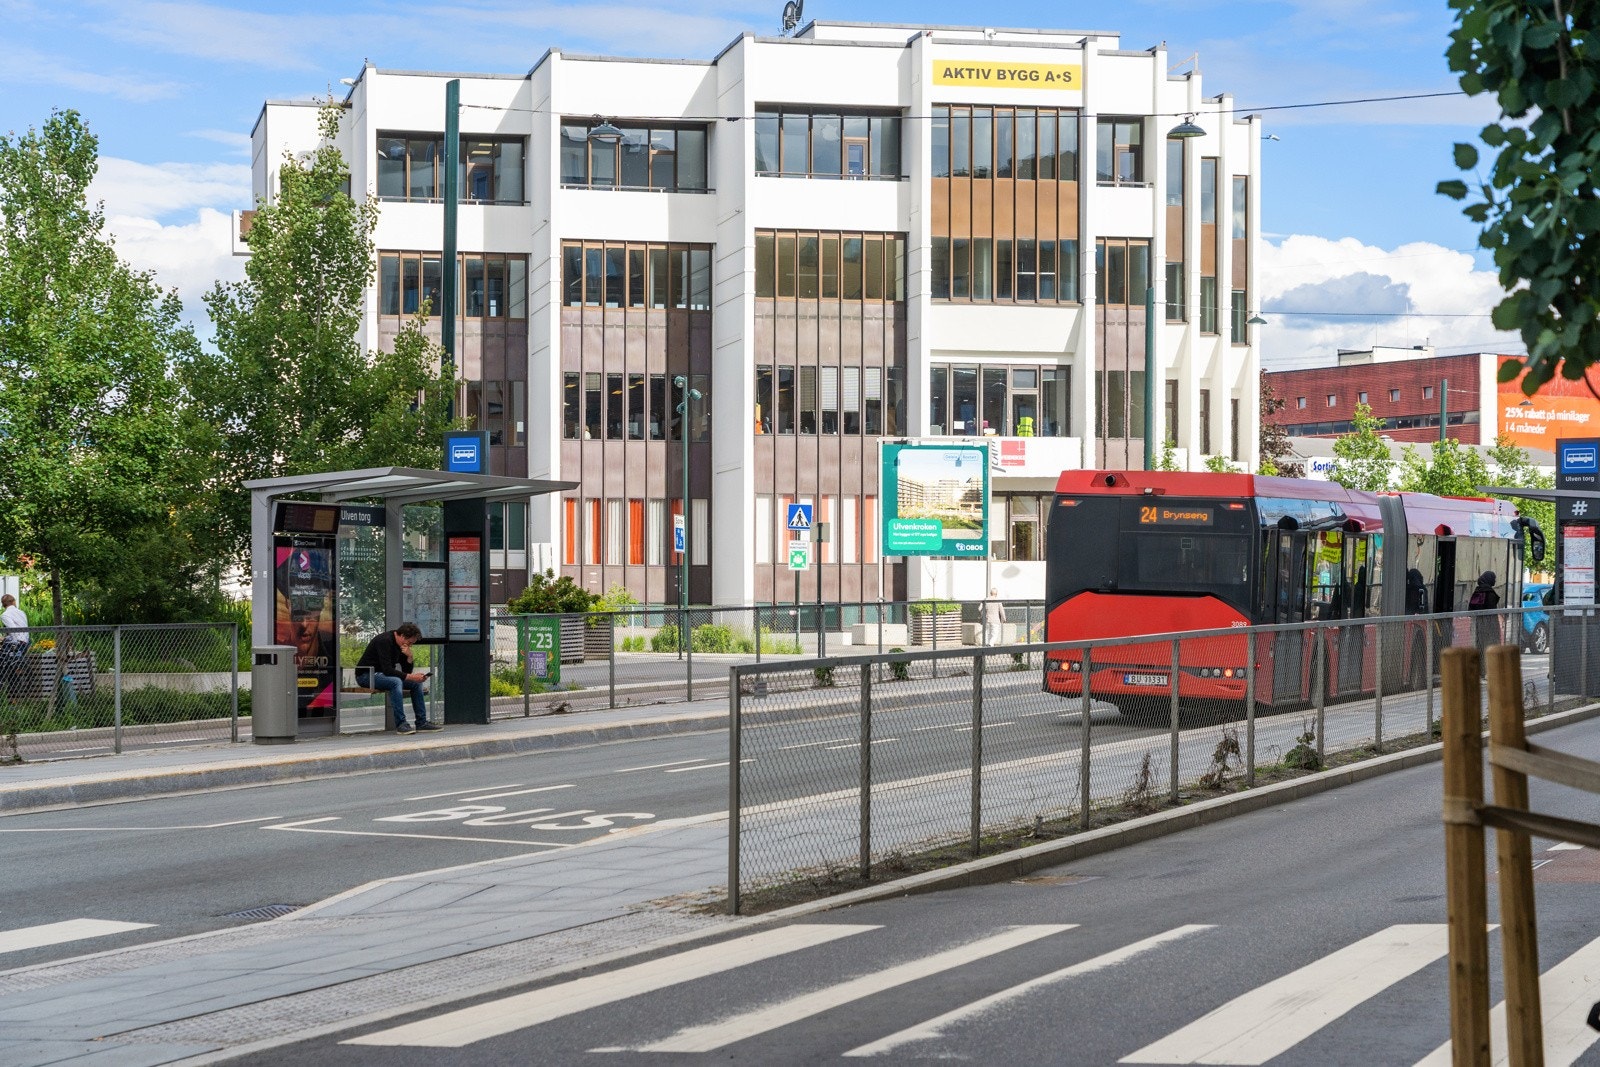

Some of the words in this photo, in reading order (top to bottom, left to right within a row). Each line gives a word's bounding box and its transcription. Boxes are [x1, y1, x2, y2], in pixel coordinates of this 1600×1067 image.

[943, 67, 991, 80] AKTIV
[997, 69, 1040, 82] BYGG
[1505, 407, 1523, 418] 25%
[1525, 408, 1545, 419] rabatt
[1547, 409, 1556, 421] på
[1557, 410, 1590, 423] minilager
[1506, 422, 1508, 432] i
[1510, 422, 1516, 432] 4
[1516, 422, 1546, 434] måneder
[341, 510, 358, 521] Ulven
[358, 512, 371, 524] torg
[1141, 506, 1157, 523] 24
[1163, 510, 1208, 521] Brynseng
[314, 656, 328, 668] KID
[372, 805, 656, 830] BUS
